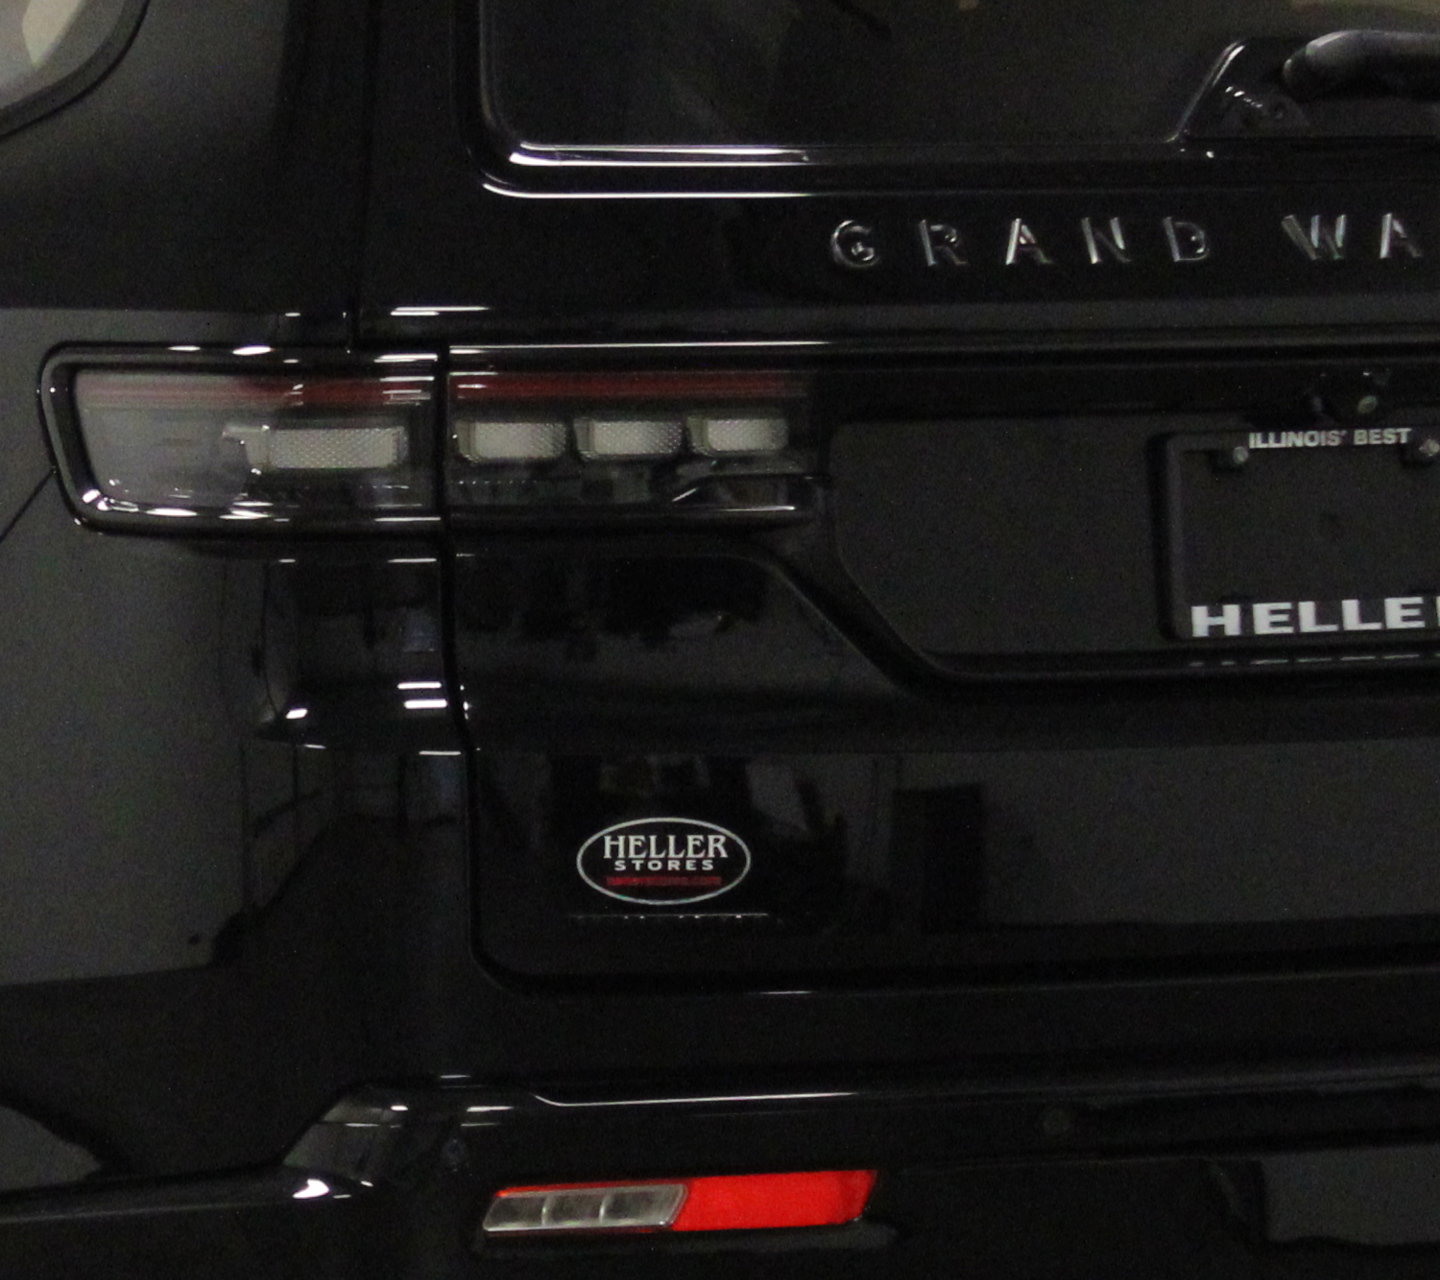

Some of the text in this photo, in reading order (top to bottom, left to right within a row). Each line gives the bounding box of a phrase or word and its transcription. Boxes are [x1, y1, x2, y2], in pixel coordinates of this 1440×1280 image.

[829, 217, 1212, 267] GRAND
[1352, 427, 1412, 446] BEST
[603, 834, 728, 859] HELLER
[614, 859, 714, 871] STORES
